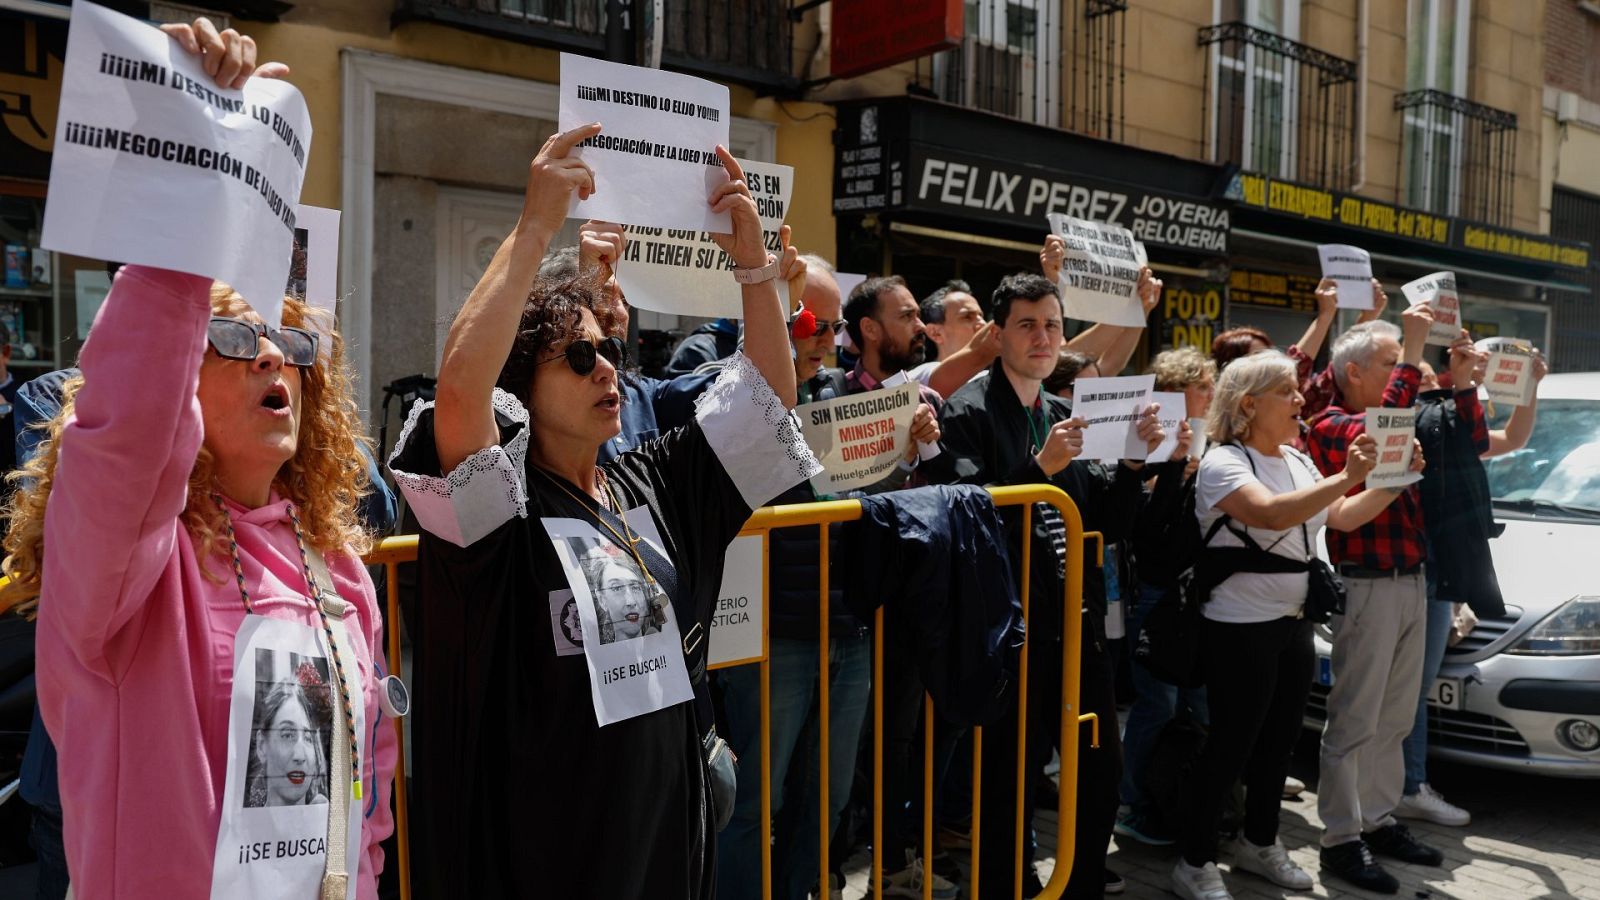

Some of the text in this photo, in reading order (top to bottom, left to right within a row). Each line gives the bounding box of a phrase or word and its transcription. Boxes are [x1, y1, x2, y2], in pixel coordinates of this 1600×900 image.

[171, 71, 247, 115] DESTINO
[252, 104, 270, 125] LO
[272, 112, 293, 146] ELIJO
[613, 89, 657, 110] DESTINO
[659, 97, 671, 112] LO
[672, 98, 695, 117] ELIJO
[653, 143, 665, 158] DE
[666, 145, 677, 161] LA
[678, 147, 701, 164] LOEO
[245, 165, 260, 190] DE
[260, 176, 269, 200] LA
[744, 171, 780, 195] ES EN
[918, 158, 1022, 214] FELIX
[1024, 178, 1127, 227] PEREZ
[753, 195, 783, 219] CIÓN
[1133, 195, 1229, 230] JOYERIA
[1131, 218, 1226, 252] RELOJERIA
[624, 239, 641, 262] YA
[646, 242, 693, 267] TIENEN
[696, 248, 715, 269] SU
[1417, 281, 1435, 293] SIN
[1164, 288, 1220, 321] FOTO
[1172, 325, 1212, 354] DNI
[811, 391, 910, 426] SIN NEGOCIACIÓN
[1377, 415, 1390, 428] SIN
[839, 417, 896, 443] MINISTRA
[841, 434, 895, 462] DIMISIÓN
[603, 655, 667, 685] ¡¡SE BUSCA!!
[239, 837, 325, 864] ¡¡SE BUSCA
